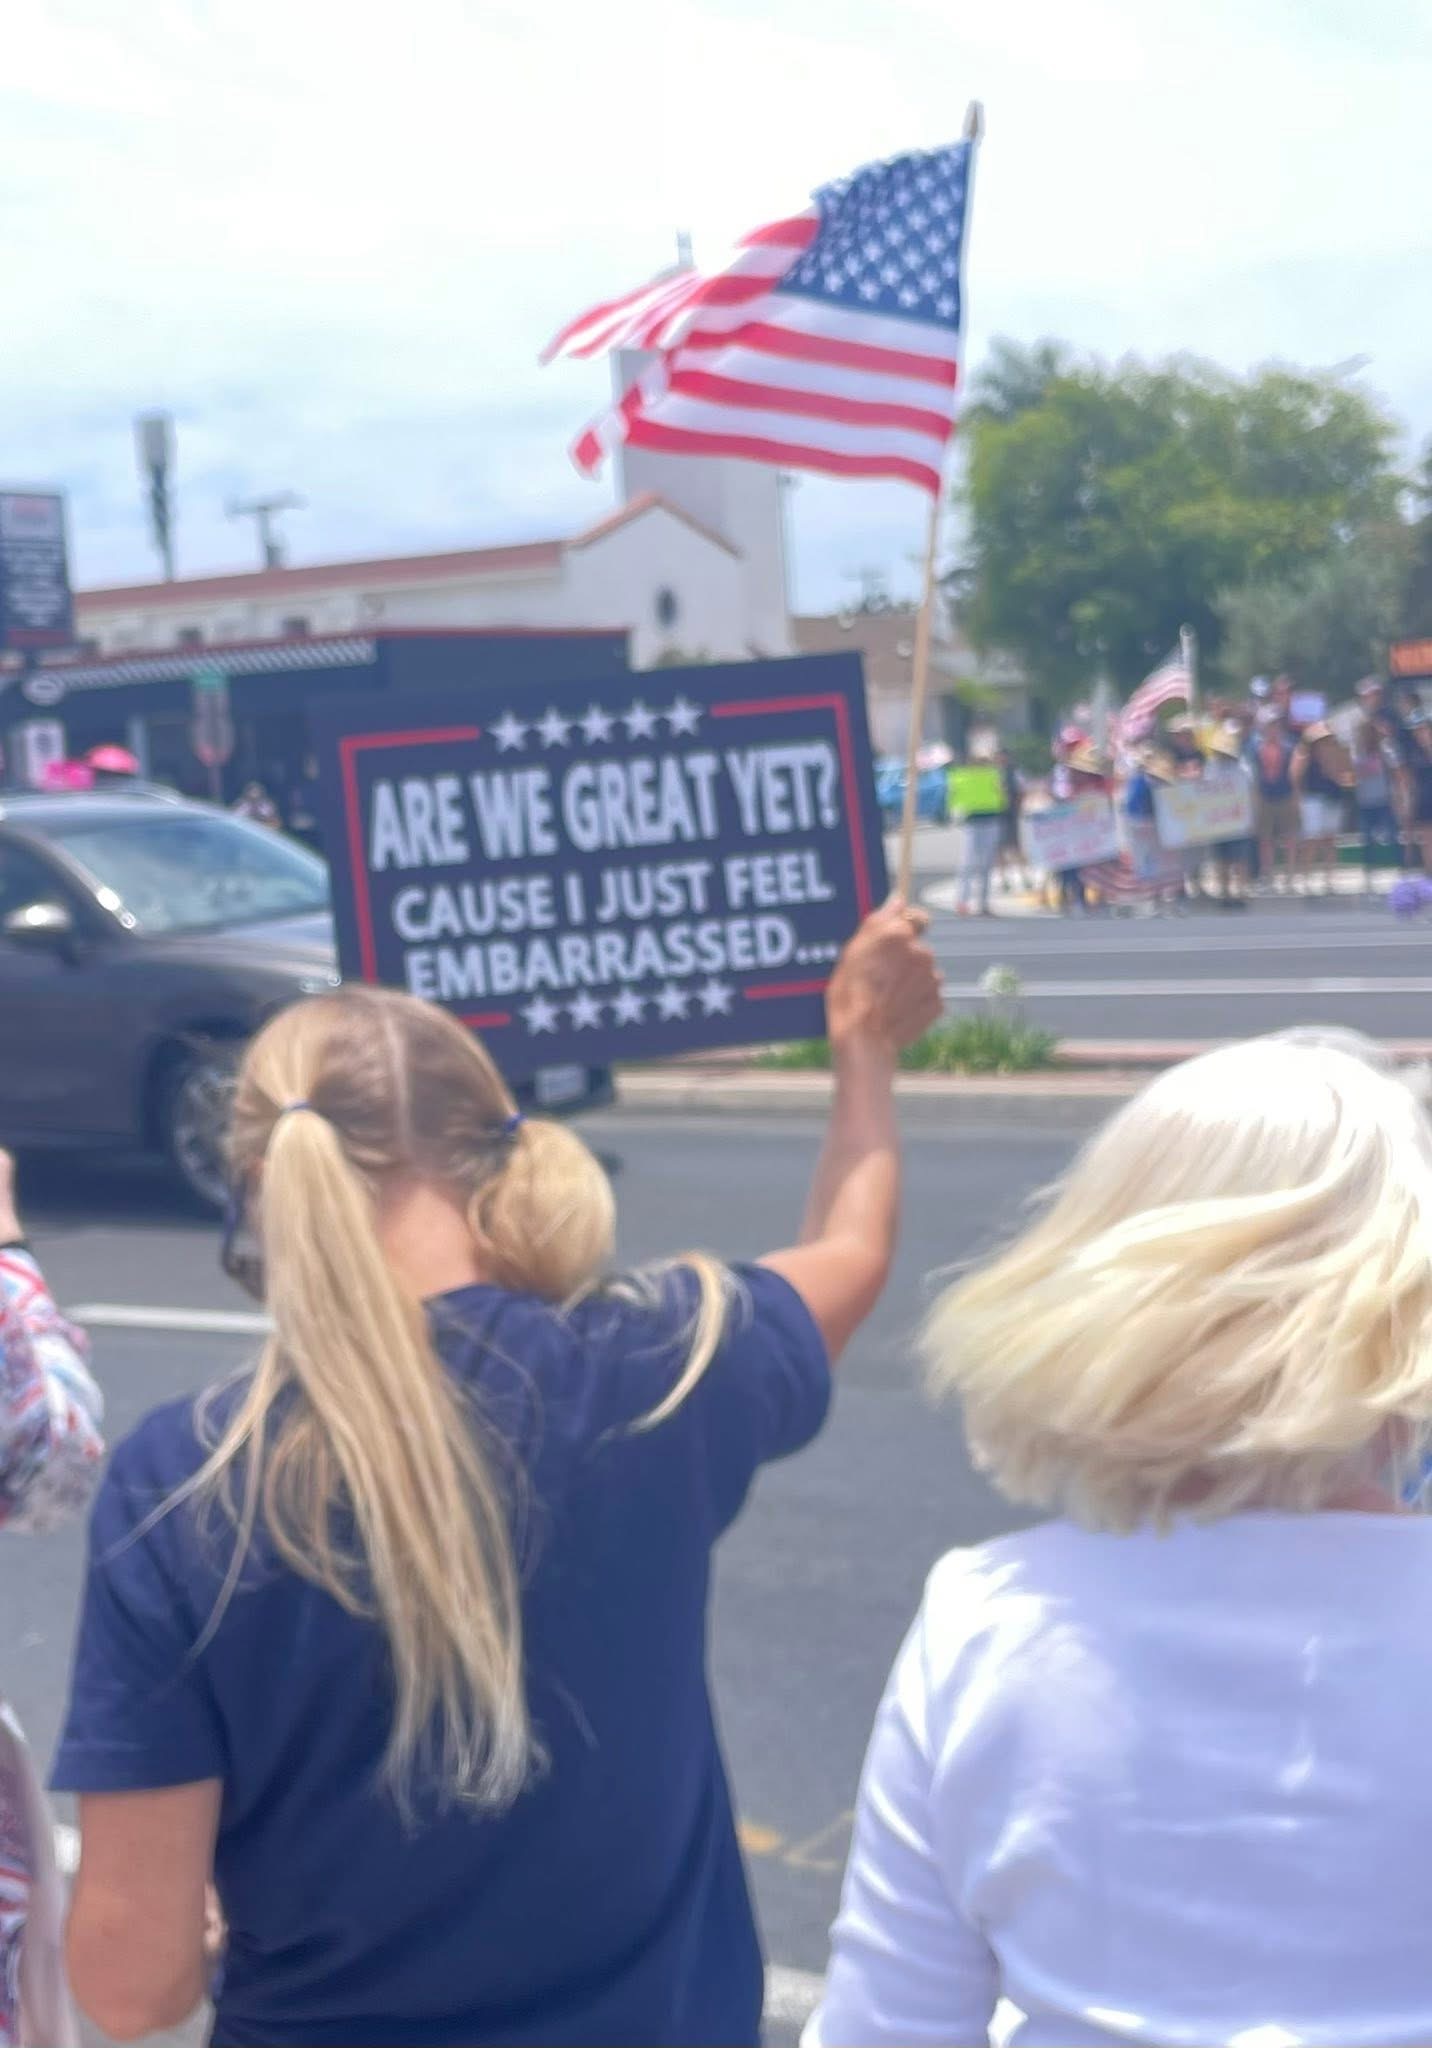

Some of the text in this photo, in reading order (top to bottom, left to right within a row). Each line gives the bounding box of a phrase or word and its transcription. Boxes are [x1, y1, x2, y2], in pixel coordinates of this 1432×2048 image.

[370, 741, 840, 871] ARE WE GREAT YET?
[394, 852, 834, 941] CAUSE I JUST FEEL
[406, 917, 839, 1001] EMBARRASSED...
